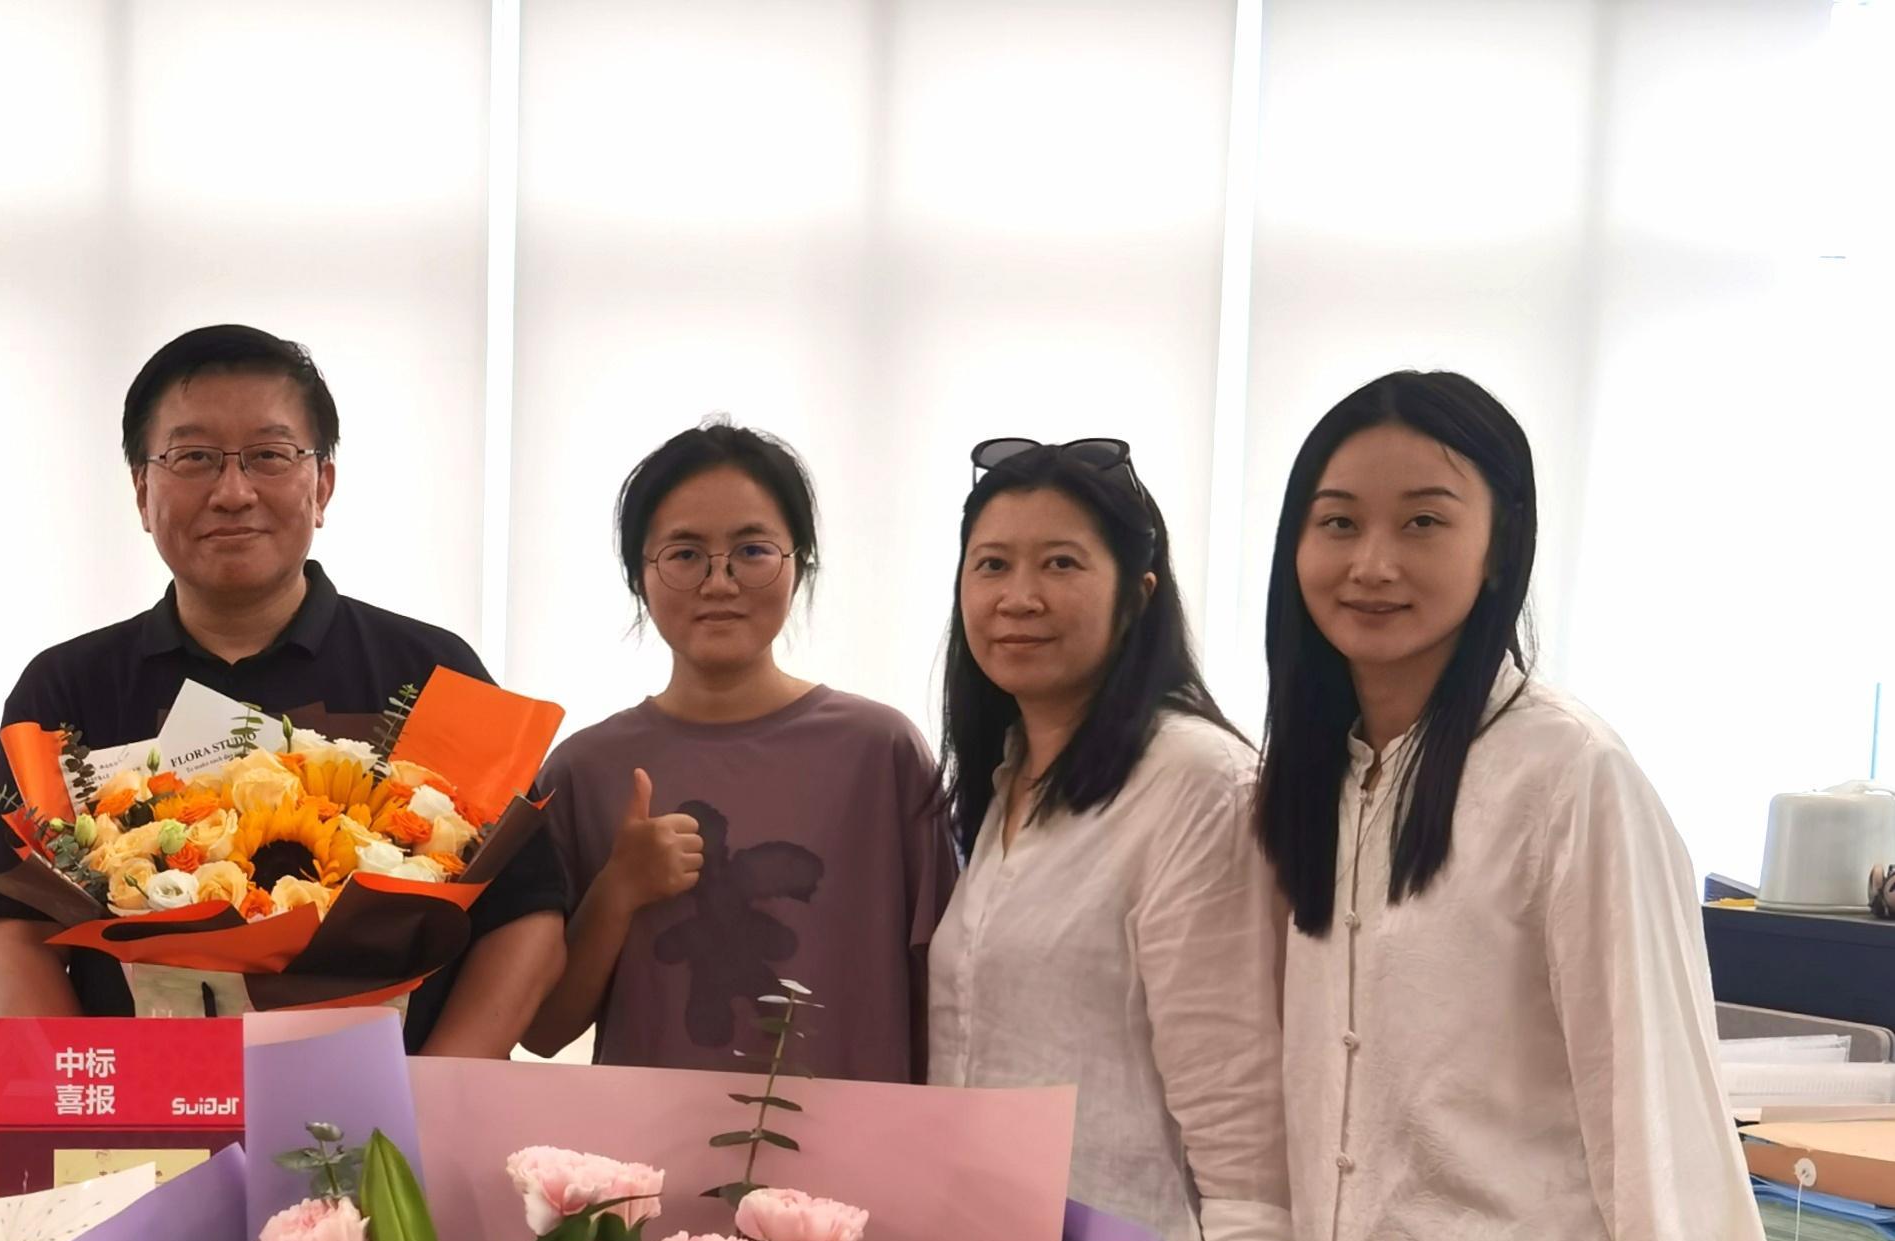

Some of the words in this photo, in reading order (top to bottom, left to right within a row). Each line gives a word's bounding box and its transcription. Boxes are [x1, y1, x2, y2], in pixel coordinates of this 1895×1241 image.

[170, 747, 211, 768] FLORA
[55, 1047, 116, 1078] 中标
[55, 1084, 116, 1116] 喜报
